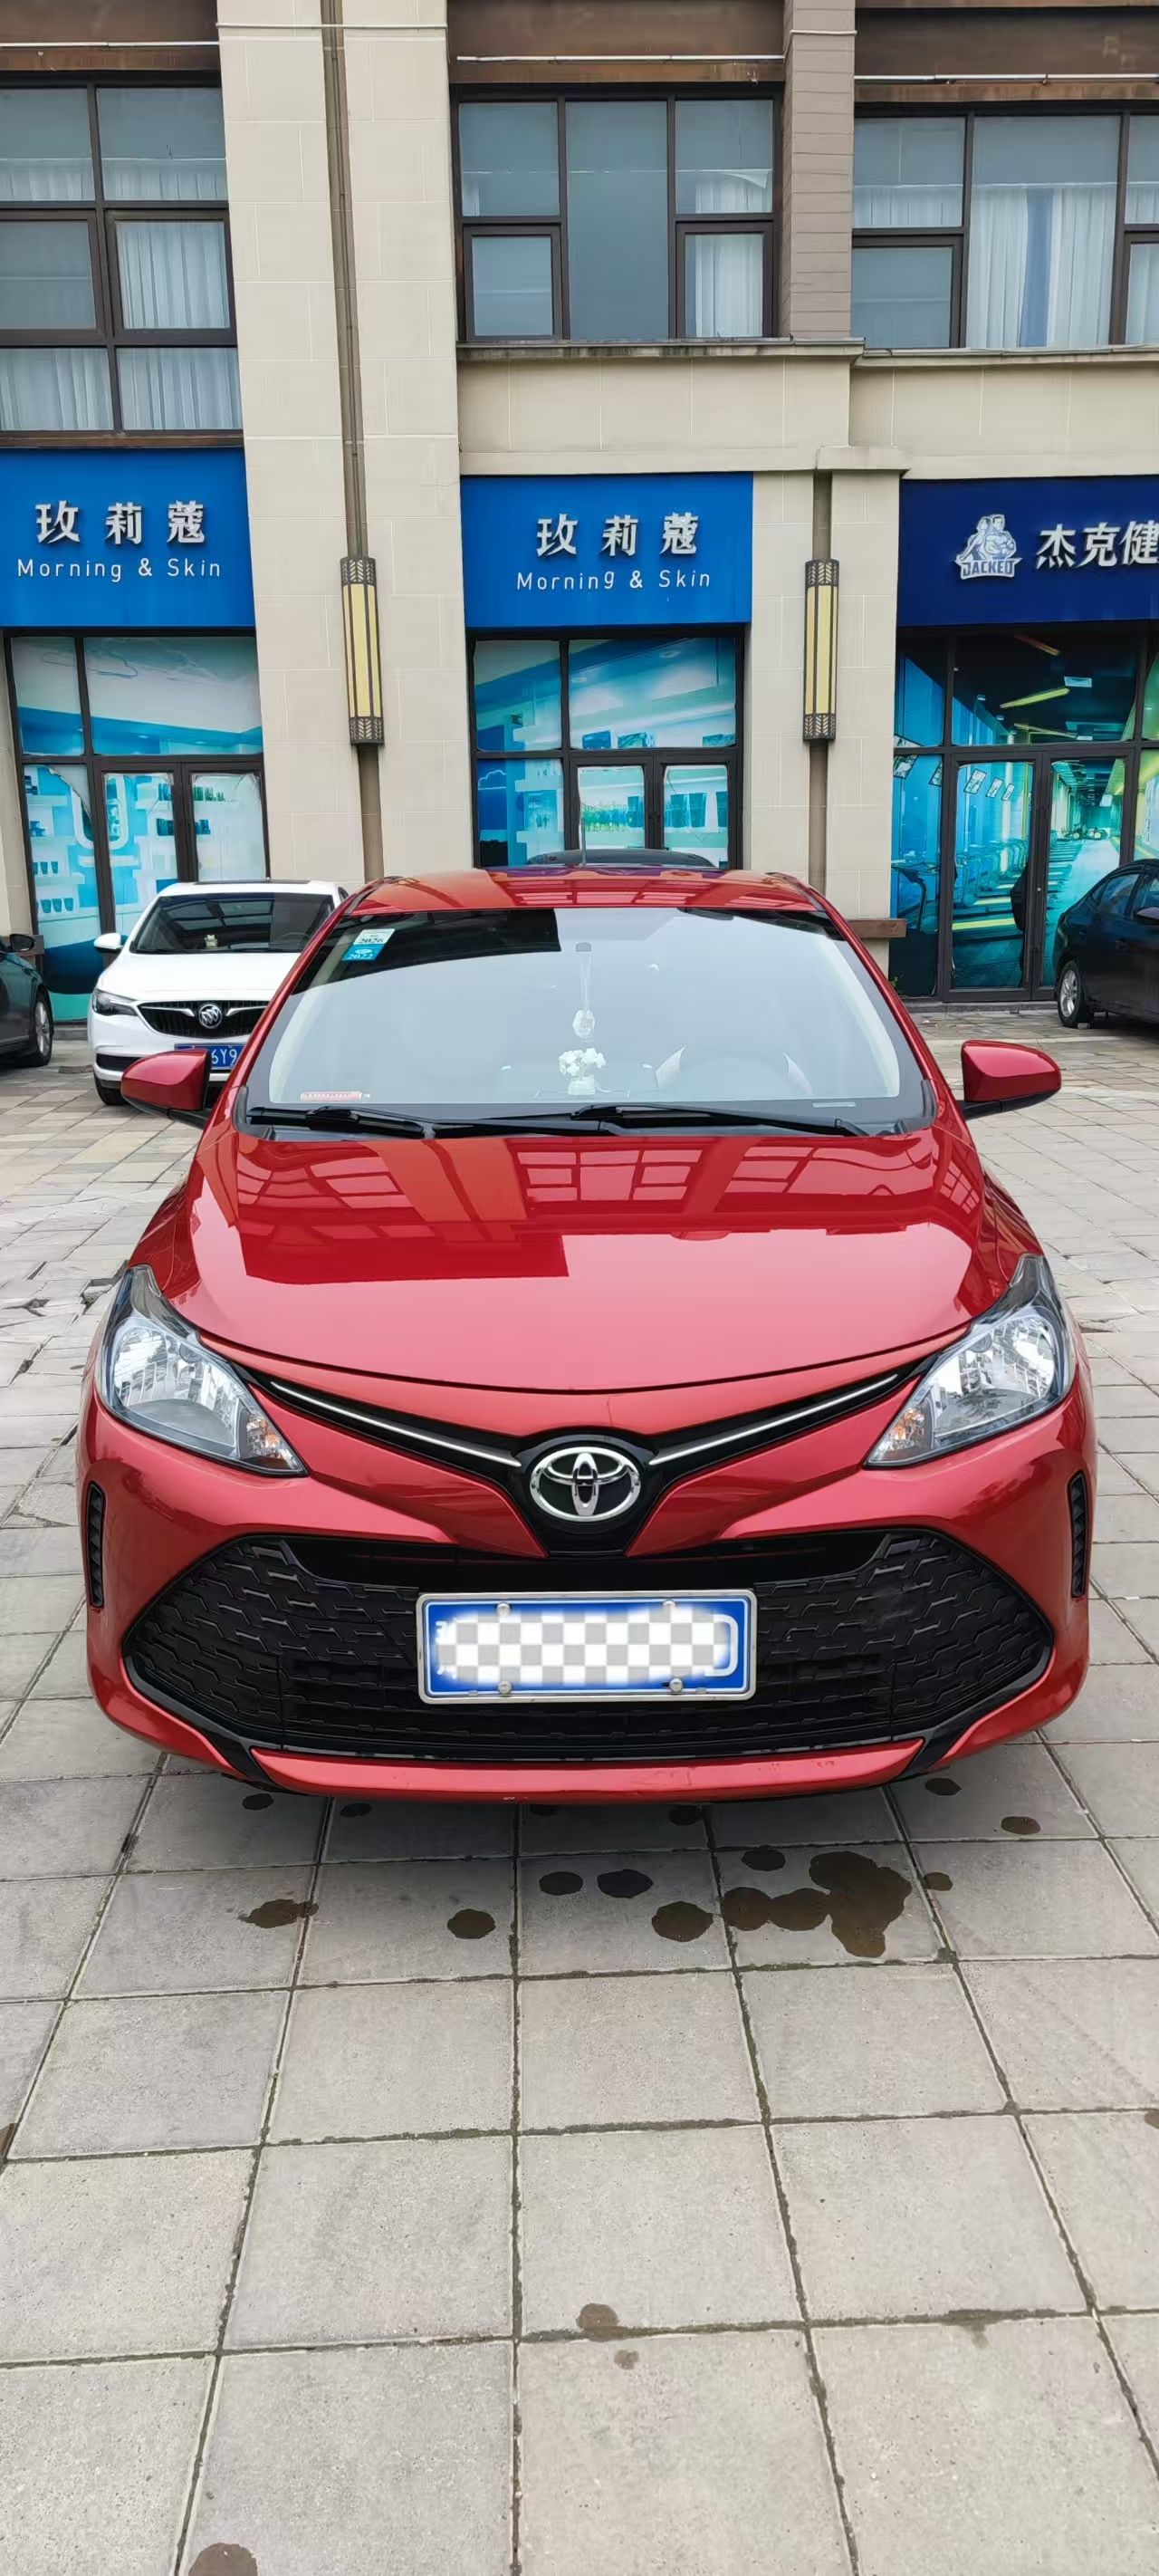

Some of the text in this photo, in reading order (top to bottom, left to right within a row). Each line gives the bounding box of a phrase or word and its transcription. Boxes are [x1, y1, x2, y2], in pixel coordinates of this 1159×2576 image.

[34, 500, 206, 544] 玫莉蔻
[536, 512, 699, 557] 玫莉蔻
[1035, 520, 1159, 569] 杰克健
[16, 557, 221, 582] Morning & Skin
[516, 570, 711, 591] Morning & Skin
[963, 560, 1014, 577] JACKED
